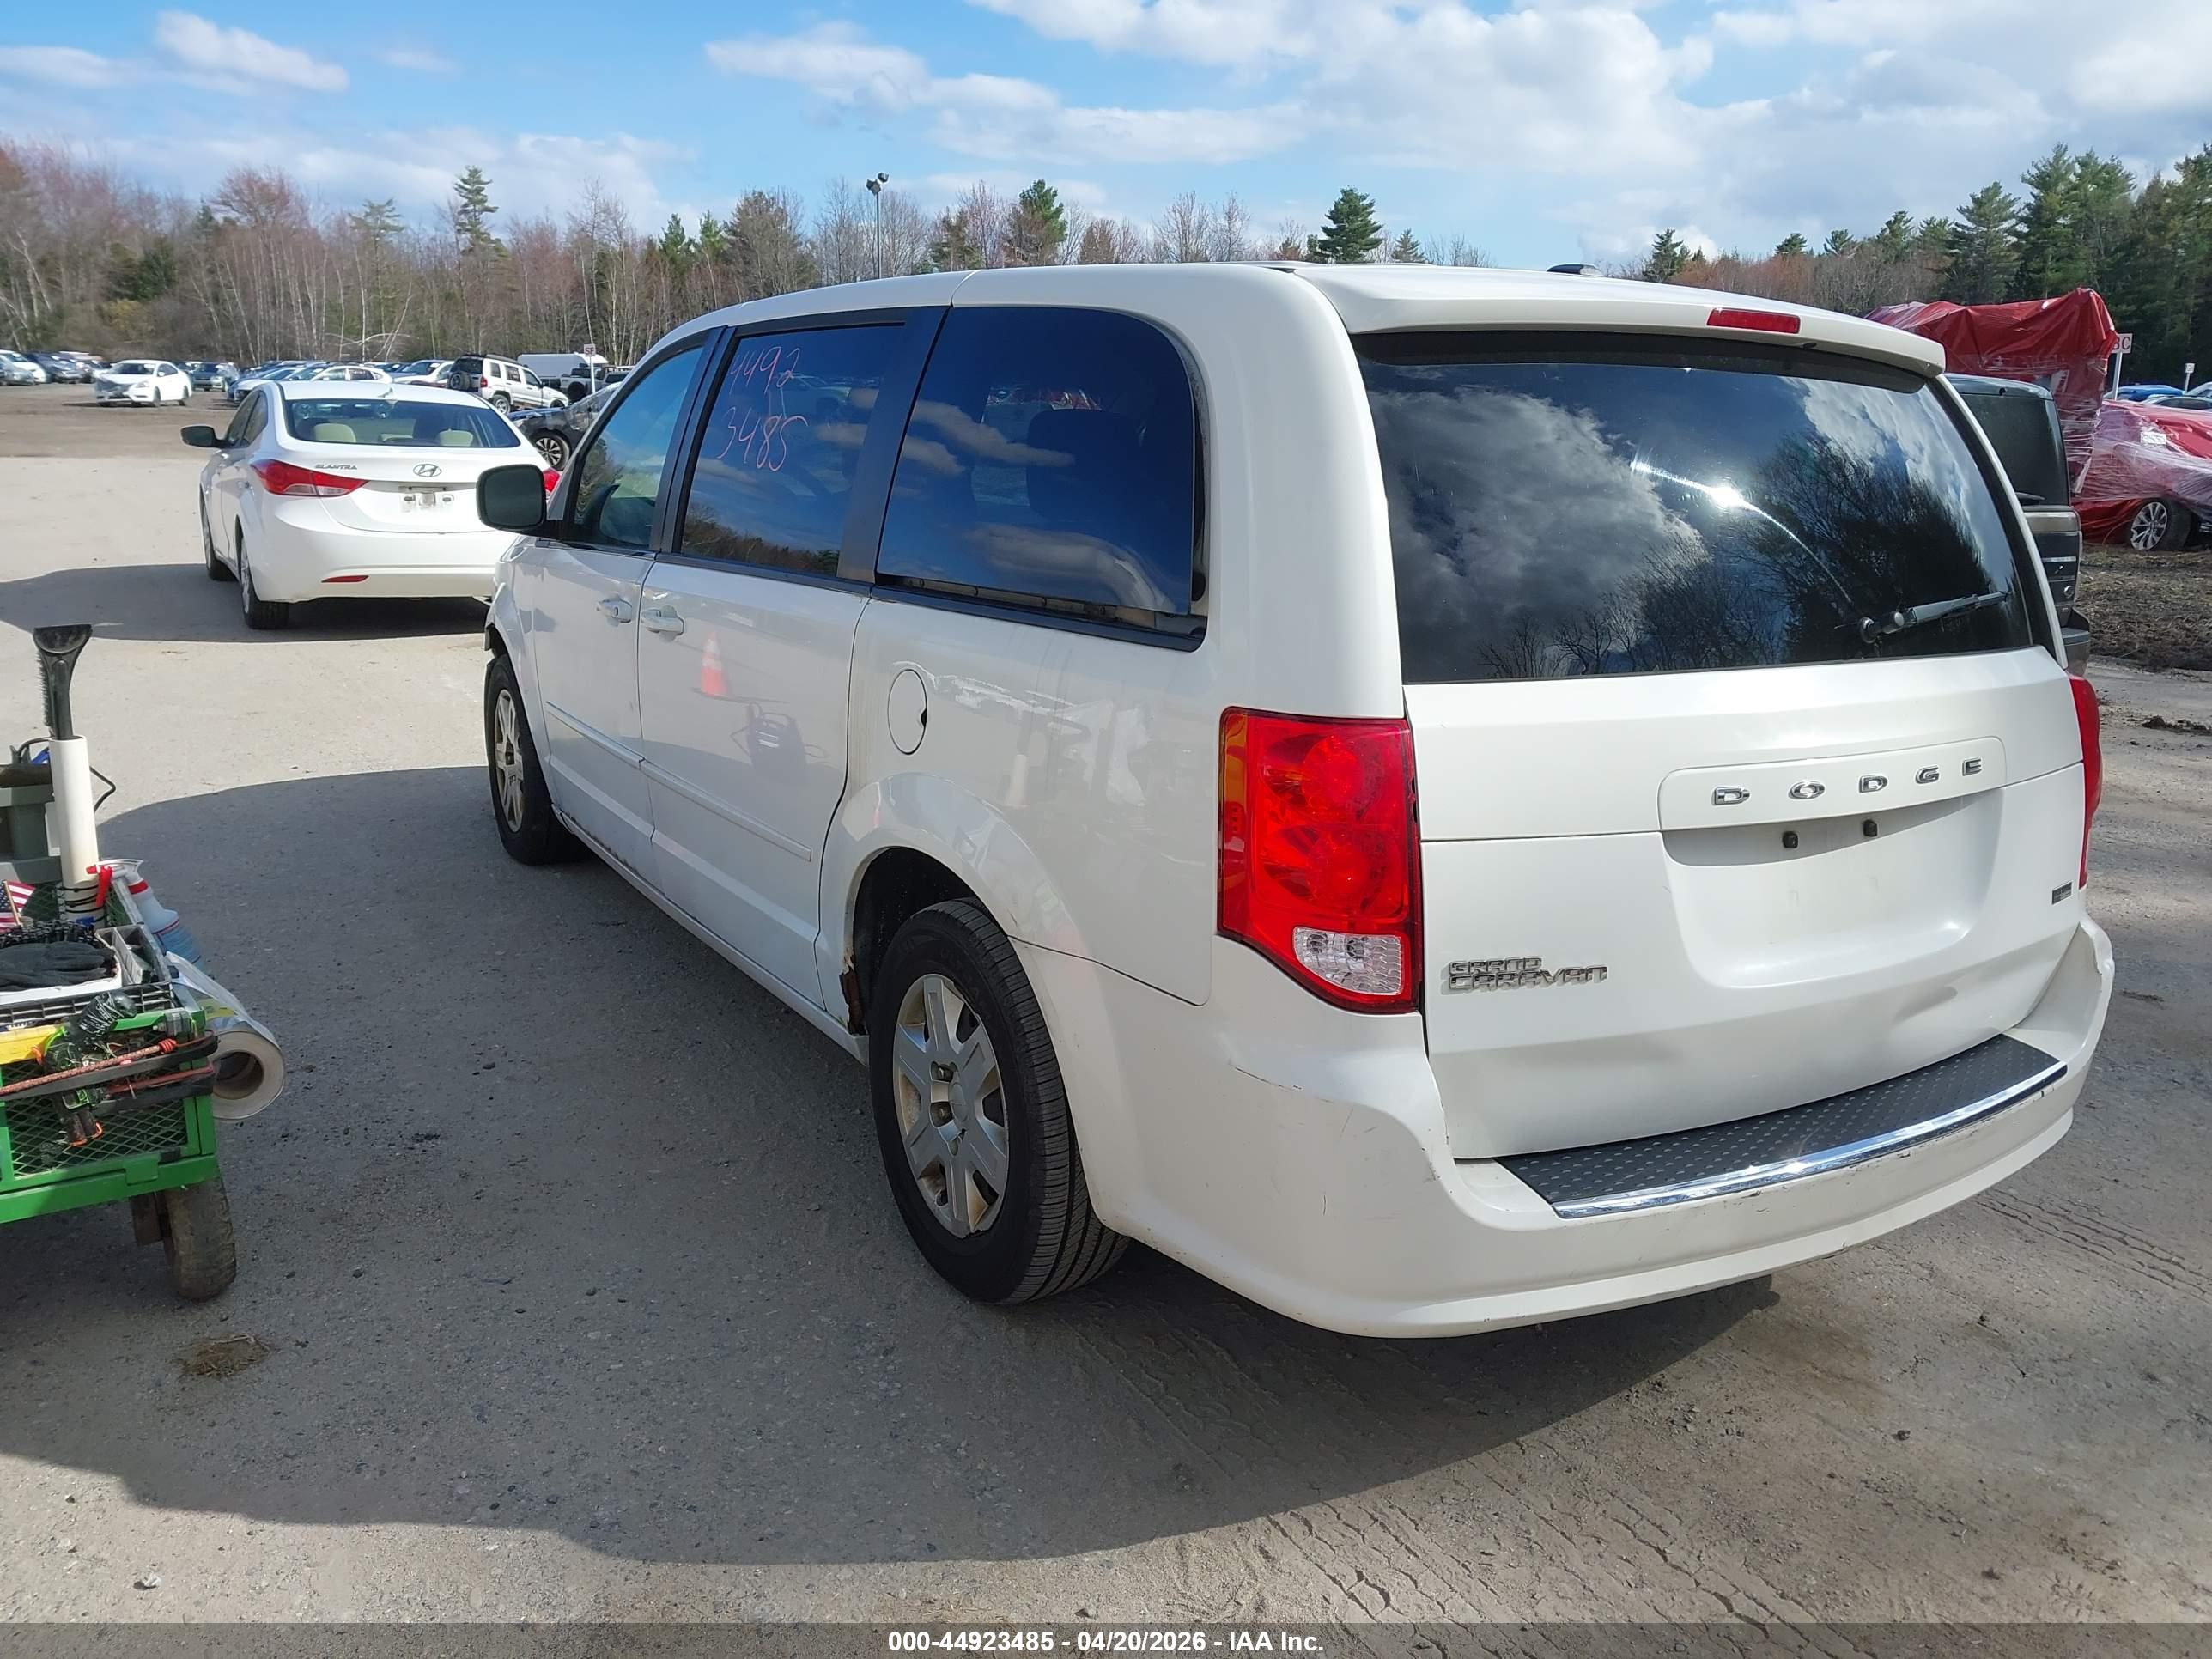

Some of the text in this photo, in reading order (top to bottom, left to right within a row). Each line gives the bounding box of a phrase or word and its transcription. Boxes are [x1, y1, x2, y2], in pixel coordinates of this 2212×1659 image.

[729, 346, 800, 394] 4492
[717, 406, 808, 471] 3485
[1712, 757, 1982, 806] DODGE
[1449, 957, 1542, 974] GRAND
[1449, 966, 1608, 991] CARAVAN
